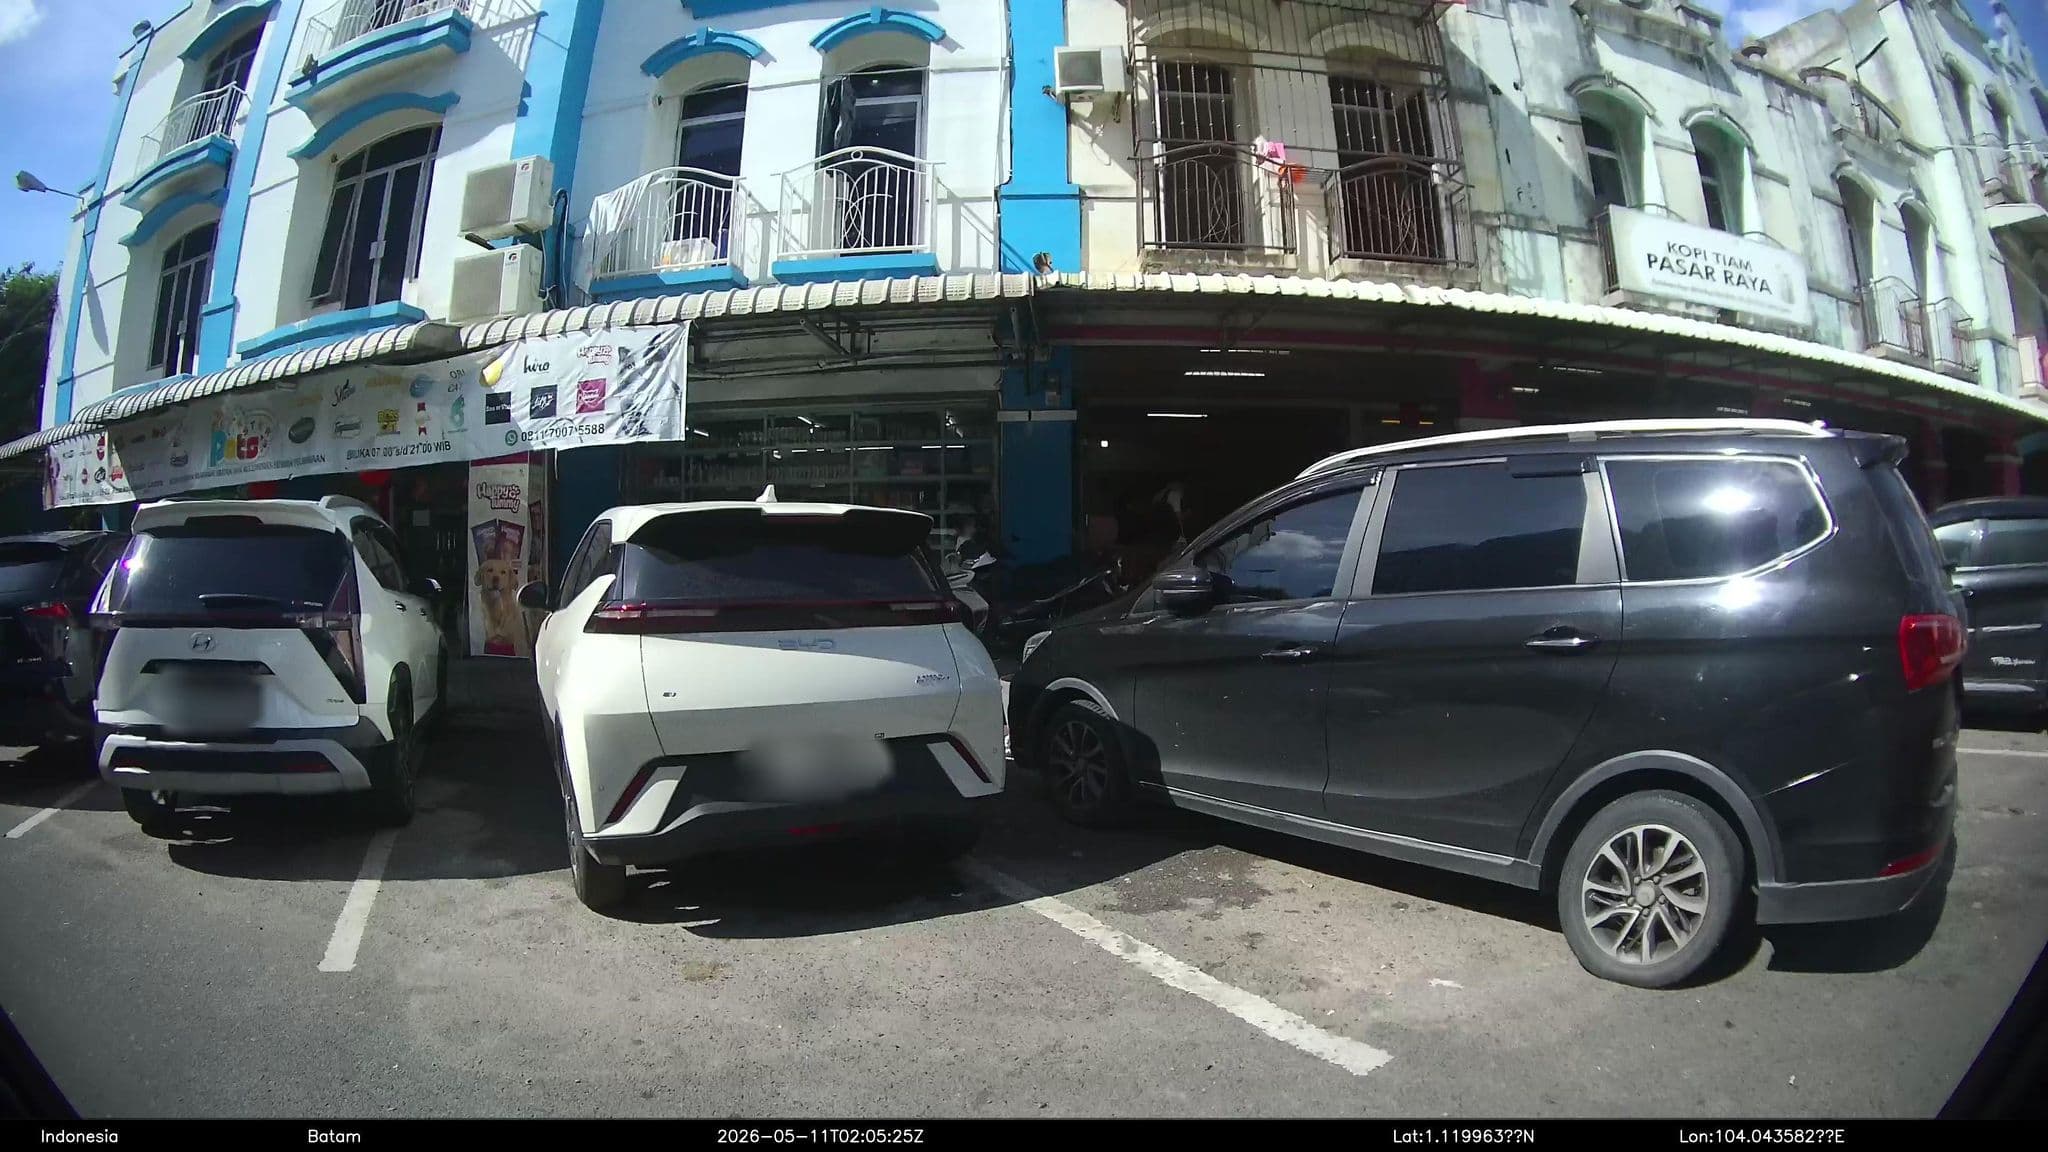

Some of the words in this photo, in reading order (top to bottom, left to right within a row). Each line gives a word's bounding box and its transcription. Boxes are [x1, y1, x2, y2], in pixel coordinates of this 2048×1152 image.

[1667, 241, 1708, 260] KOPI
[1713, 251, 1752, 272] TIAM
[1647, 253, 1716, 282] PASAR
[1723, 269, 1772, 295] RAYA
[523, 354, 550, 374] hiro
[521, 429, 544, 441] 0811
[549, 426, 574, 438] 7007
[578, 423, 605, 436] 5588
[434, 440, 451, 452] WIB
